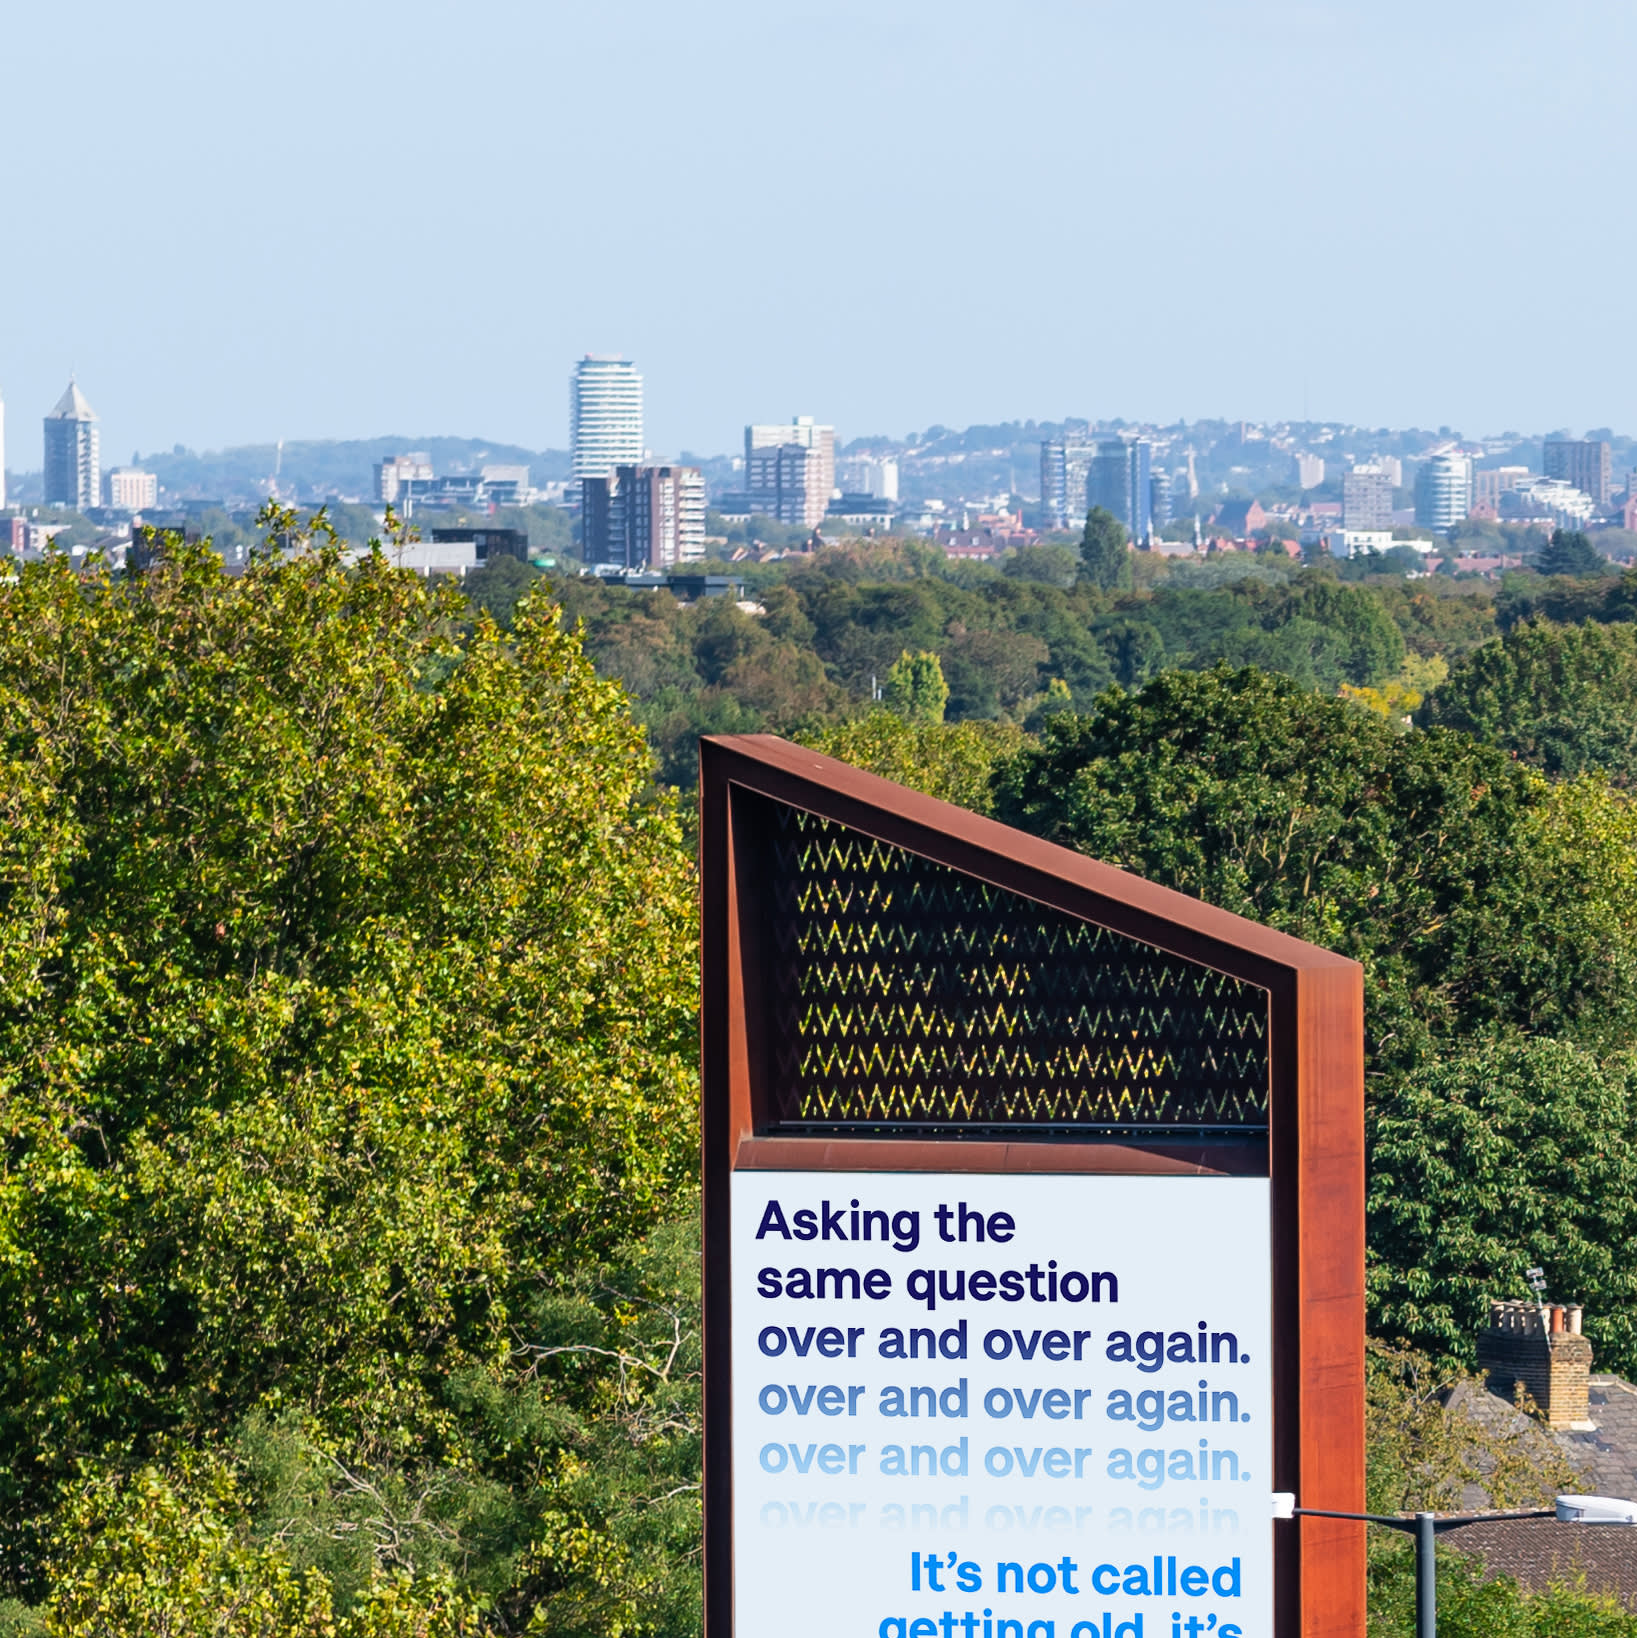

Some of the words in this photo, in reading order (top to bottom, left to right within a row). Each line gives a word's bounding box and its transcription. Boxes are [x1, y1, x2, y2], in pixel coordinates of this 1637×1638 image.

[755, 1199, 920, 1252] Asking
[933, 1202, 1015, 1243] the
[757, 1267, 892, 1300] same
[907, 1260, 1118, 1310] question
[758, 1326, 865, 1358] over
[878, 1319, 967, 1359] and
[983, 1329, 1091, 1361] over
[1106, 1321, 1250, 1373] again.
[759, 1384, 865, 1416] over
[879, 1378, 968, 1418] and
[984, 1387, 1091, 1419] over
[1106, 1379, 1250, 1431] again.
[760, 1443, 866, 1474] over
[880, 1436, 968, 1476] and
[984, 1446, 1092, 1478] over
[1107, 1438, 1251, 1490] again.
[912, 1551, 982, 1593] It’s
[997, 1556, 1080, 1594] not
[1091, 1555, 1241, 1597] called
